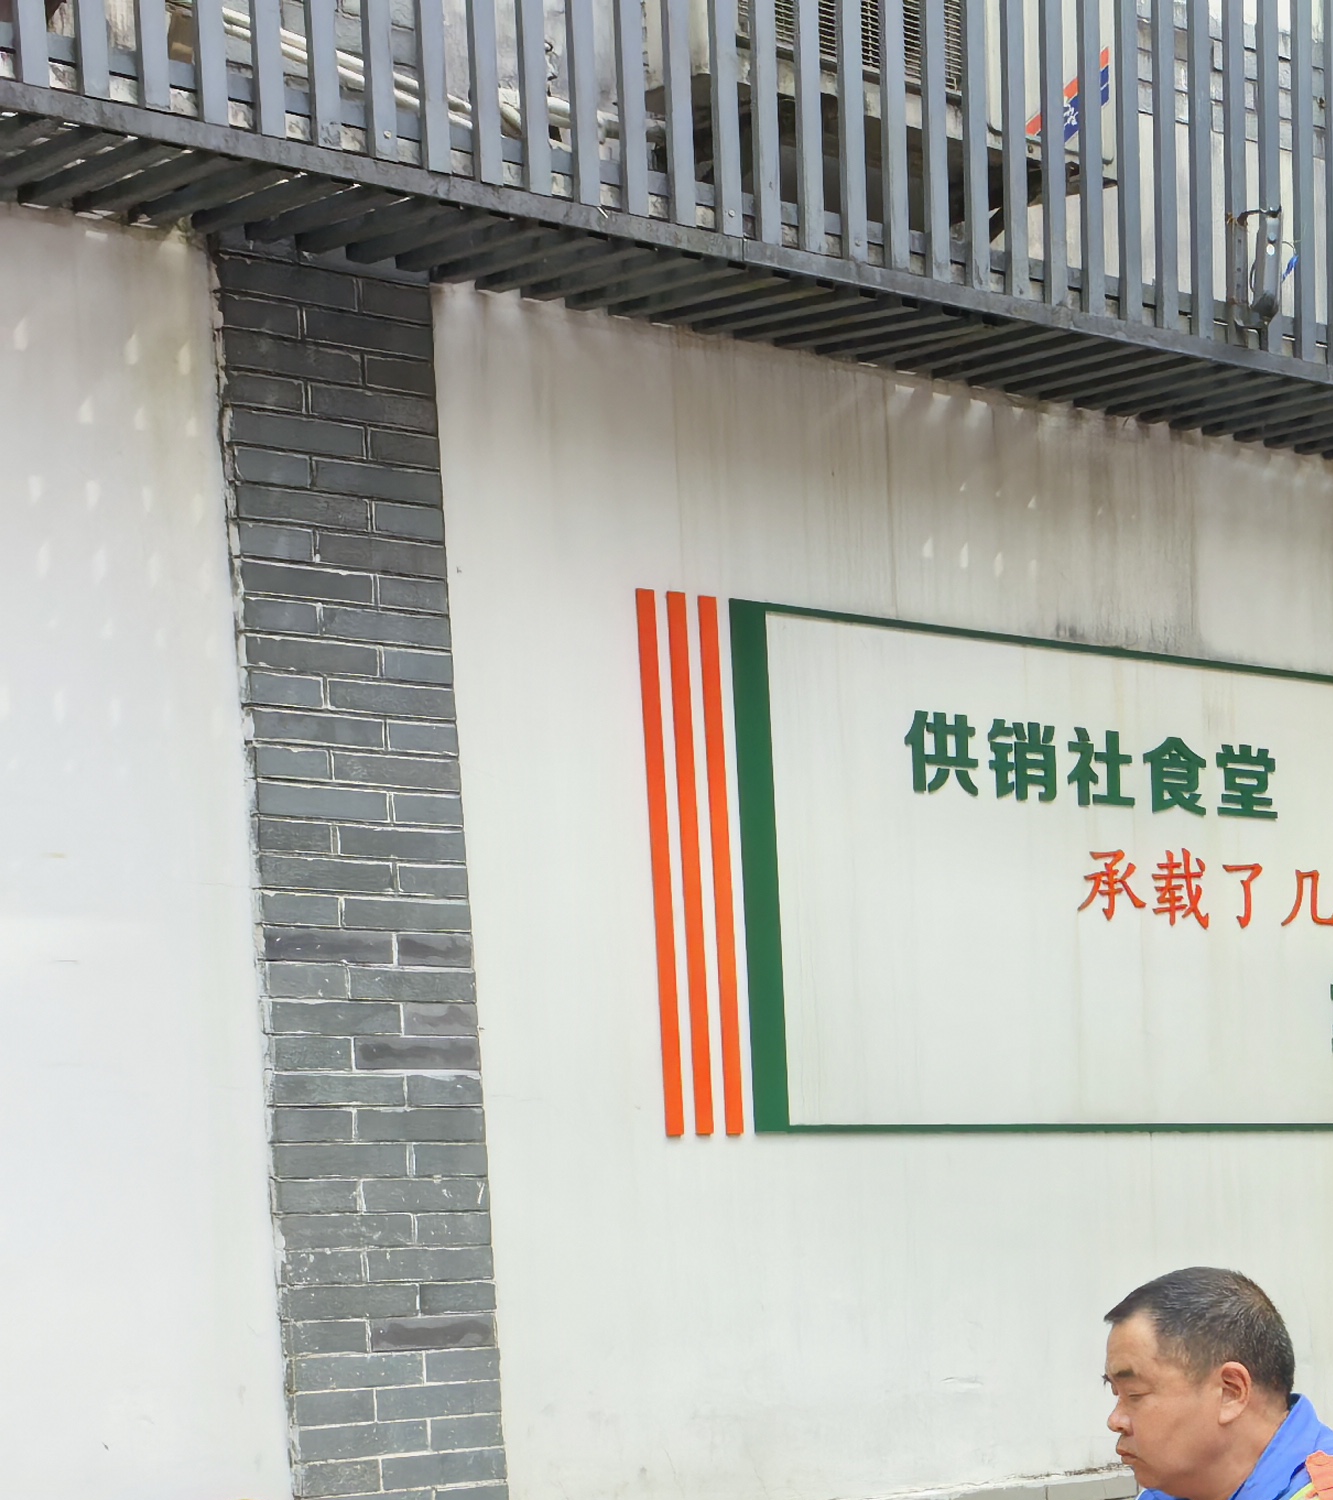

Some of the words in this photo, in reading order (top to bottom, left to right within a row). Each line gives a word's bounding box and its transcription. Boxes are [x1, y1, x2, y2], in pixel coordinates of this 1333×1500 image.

[902, 709, 1278, 822] 供销社食堂
